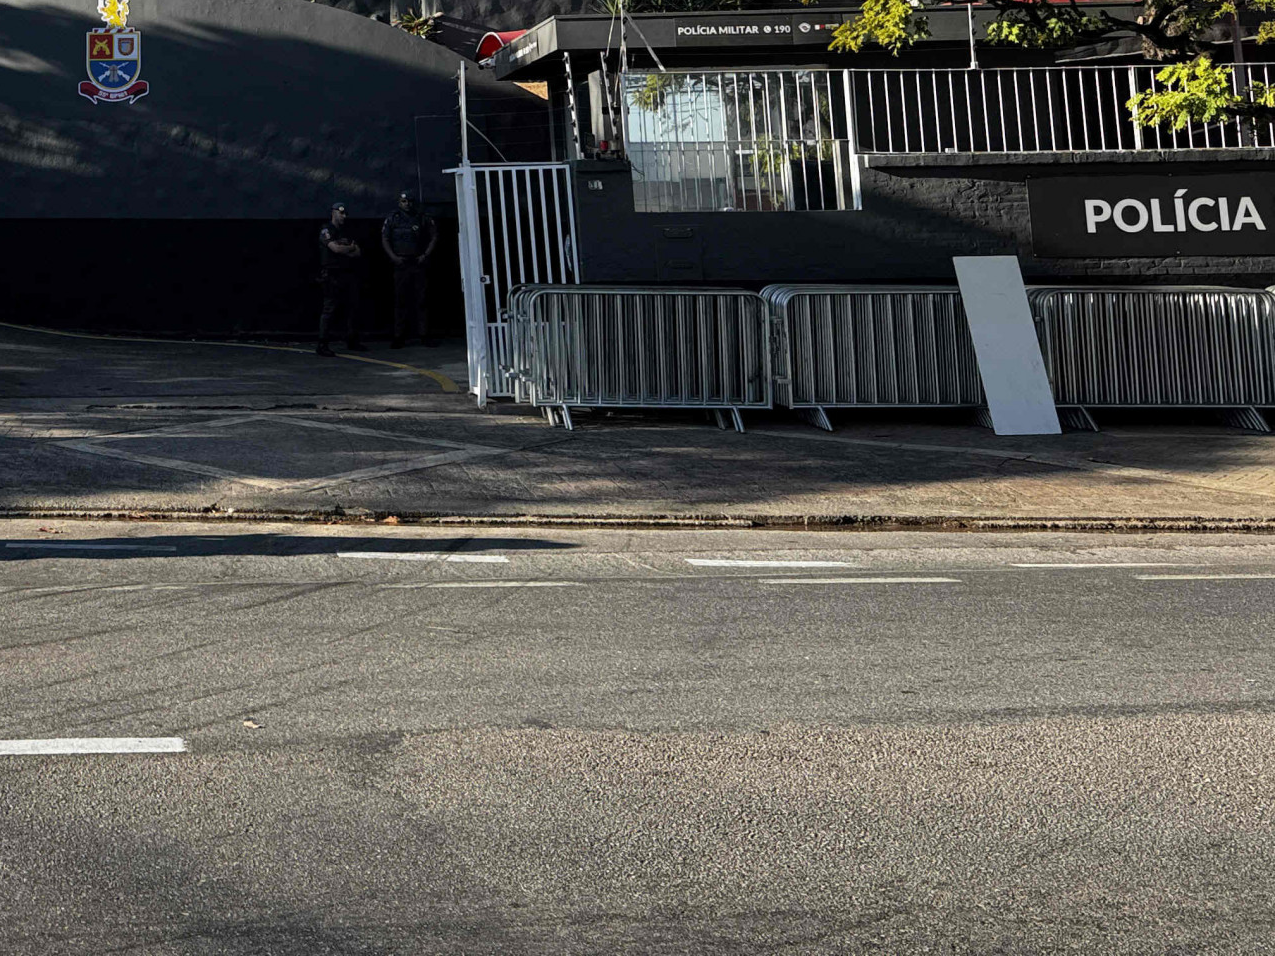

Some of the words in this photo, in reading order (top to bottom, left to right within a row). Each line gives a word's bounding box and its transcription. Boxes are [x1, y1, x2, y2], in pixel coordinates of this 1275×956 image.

[677, 24, 718, 36] POLÍCIA
[719, 25, 759, 35] MILITAR
[774, 24, 791, 34] 190
[1084, 188, 1267, 234] POLÍCIA
